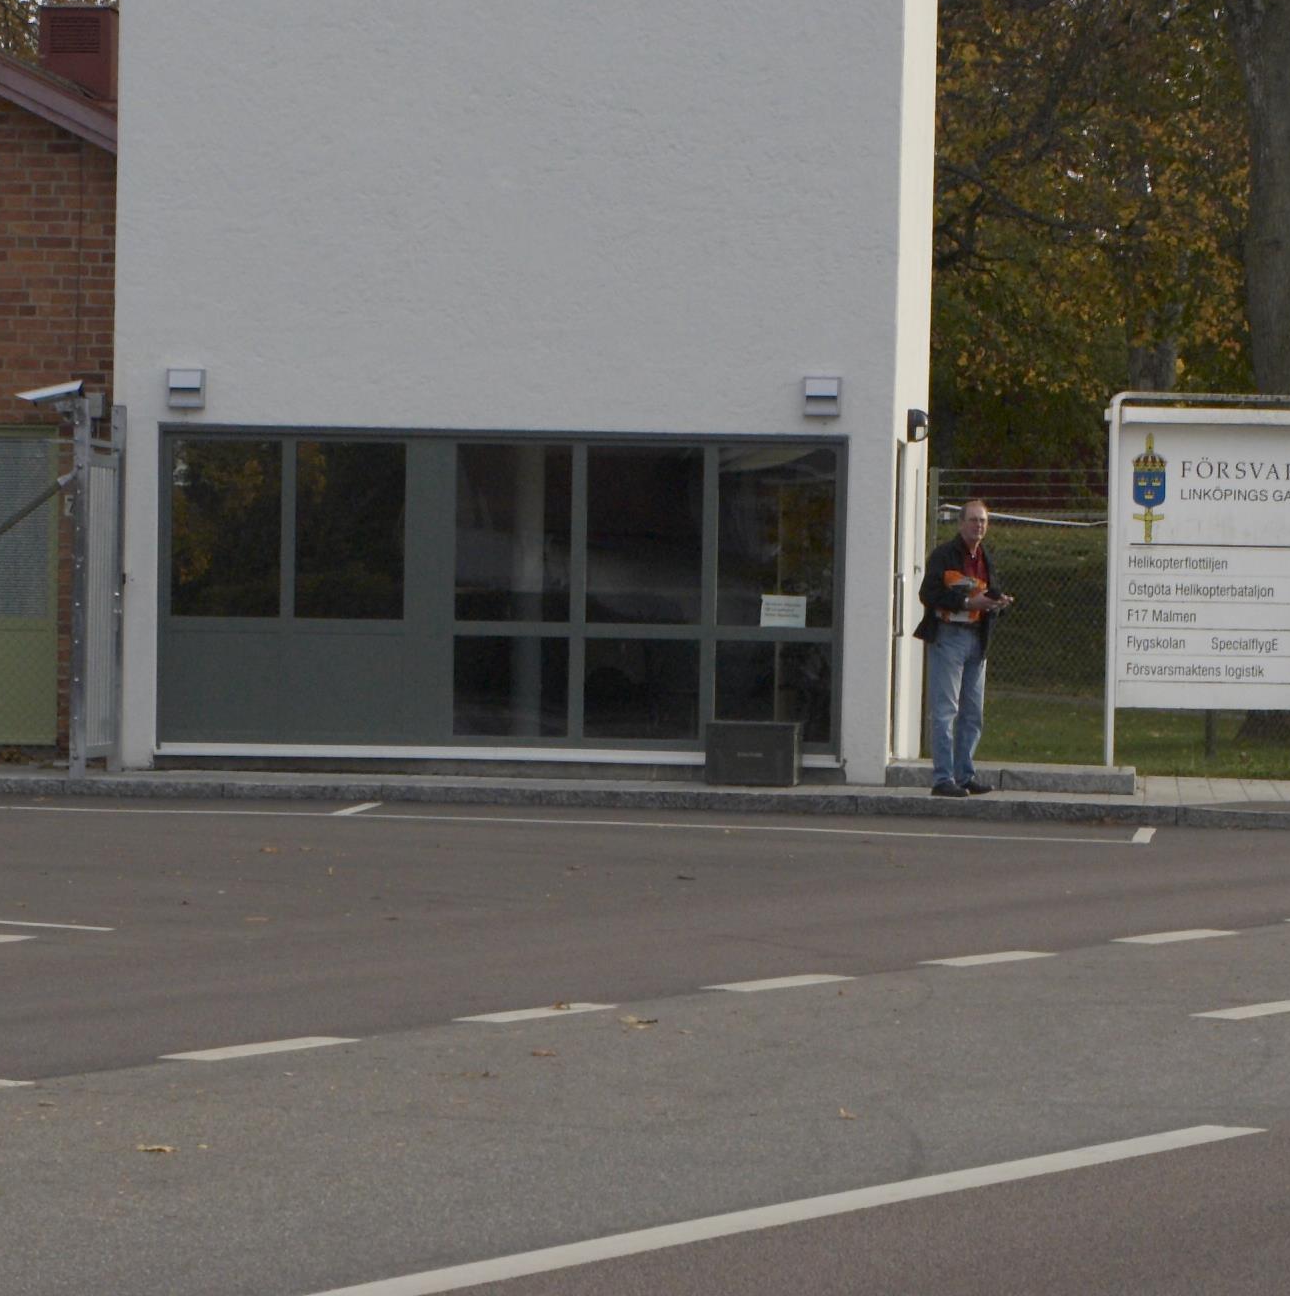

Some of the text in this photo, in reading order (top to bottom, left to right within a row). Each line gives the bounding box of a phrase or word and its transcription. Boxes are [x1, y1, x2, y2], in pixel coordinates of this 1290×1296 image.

[1180, 486, 1268, 502] LINKÖPINGS
[1128, 555, 1228, 573] Helikopterflottiljen
[1128, 580, 1274, 600] Östgöta Helikopterbataljon
[1127, 609, 1197, 623] F17 Malmen
[1127, 636, 1186, 652] Flygskolan
[1126, 662, 1265, 680] Försvarsmaktens logistik
